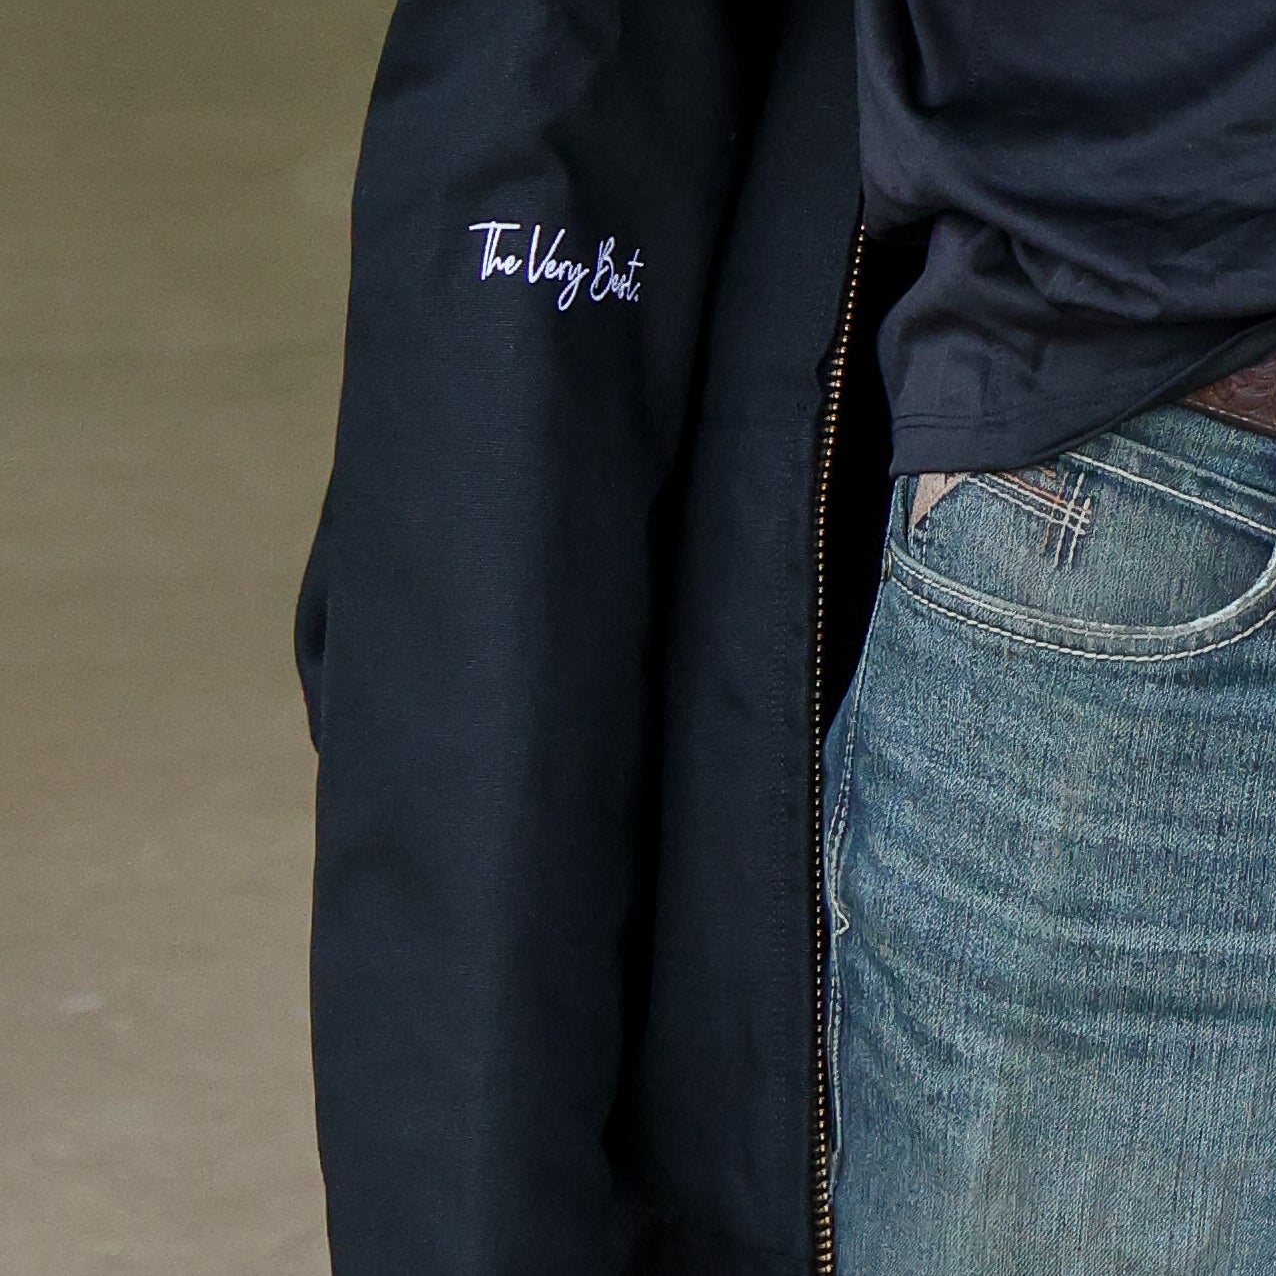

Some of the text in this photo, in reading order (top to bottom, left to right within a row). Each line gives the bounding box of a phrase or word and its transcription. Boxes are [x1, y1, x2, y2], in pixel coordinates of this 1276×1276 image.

[468, 220, 645, 312] The Very Best.
